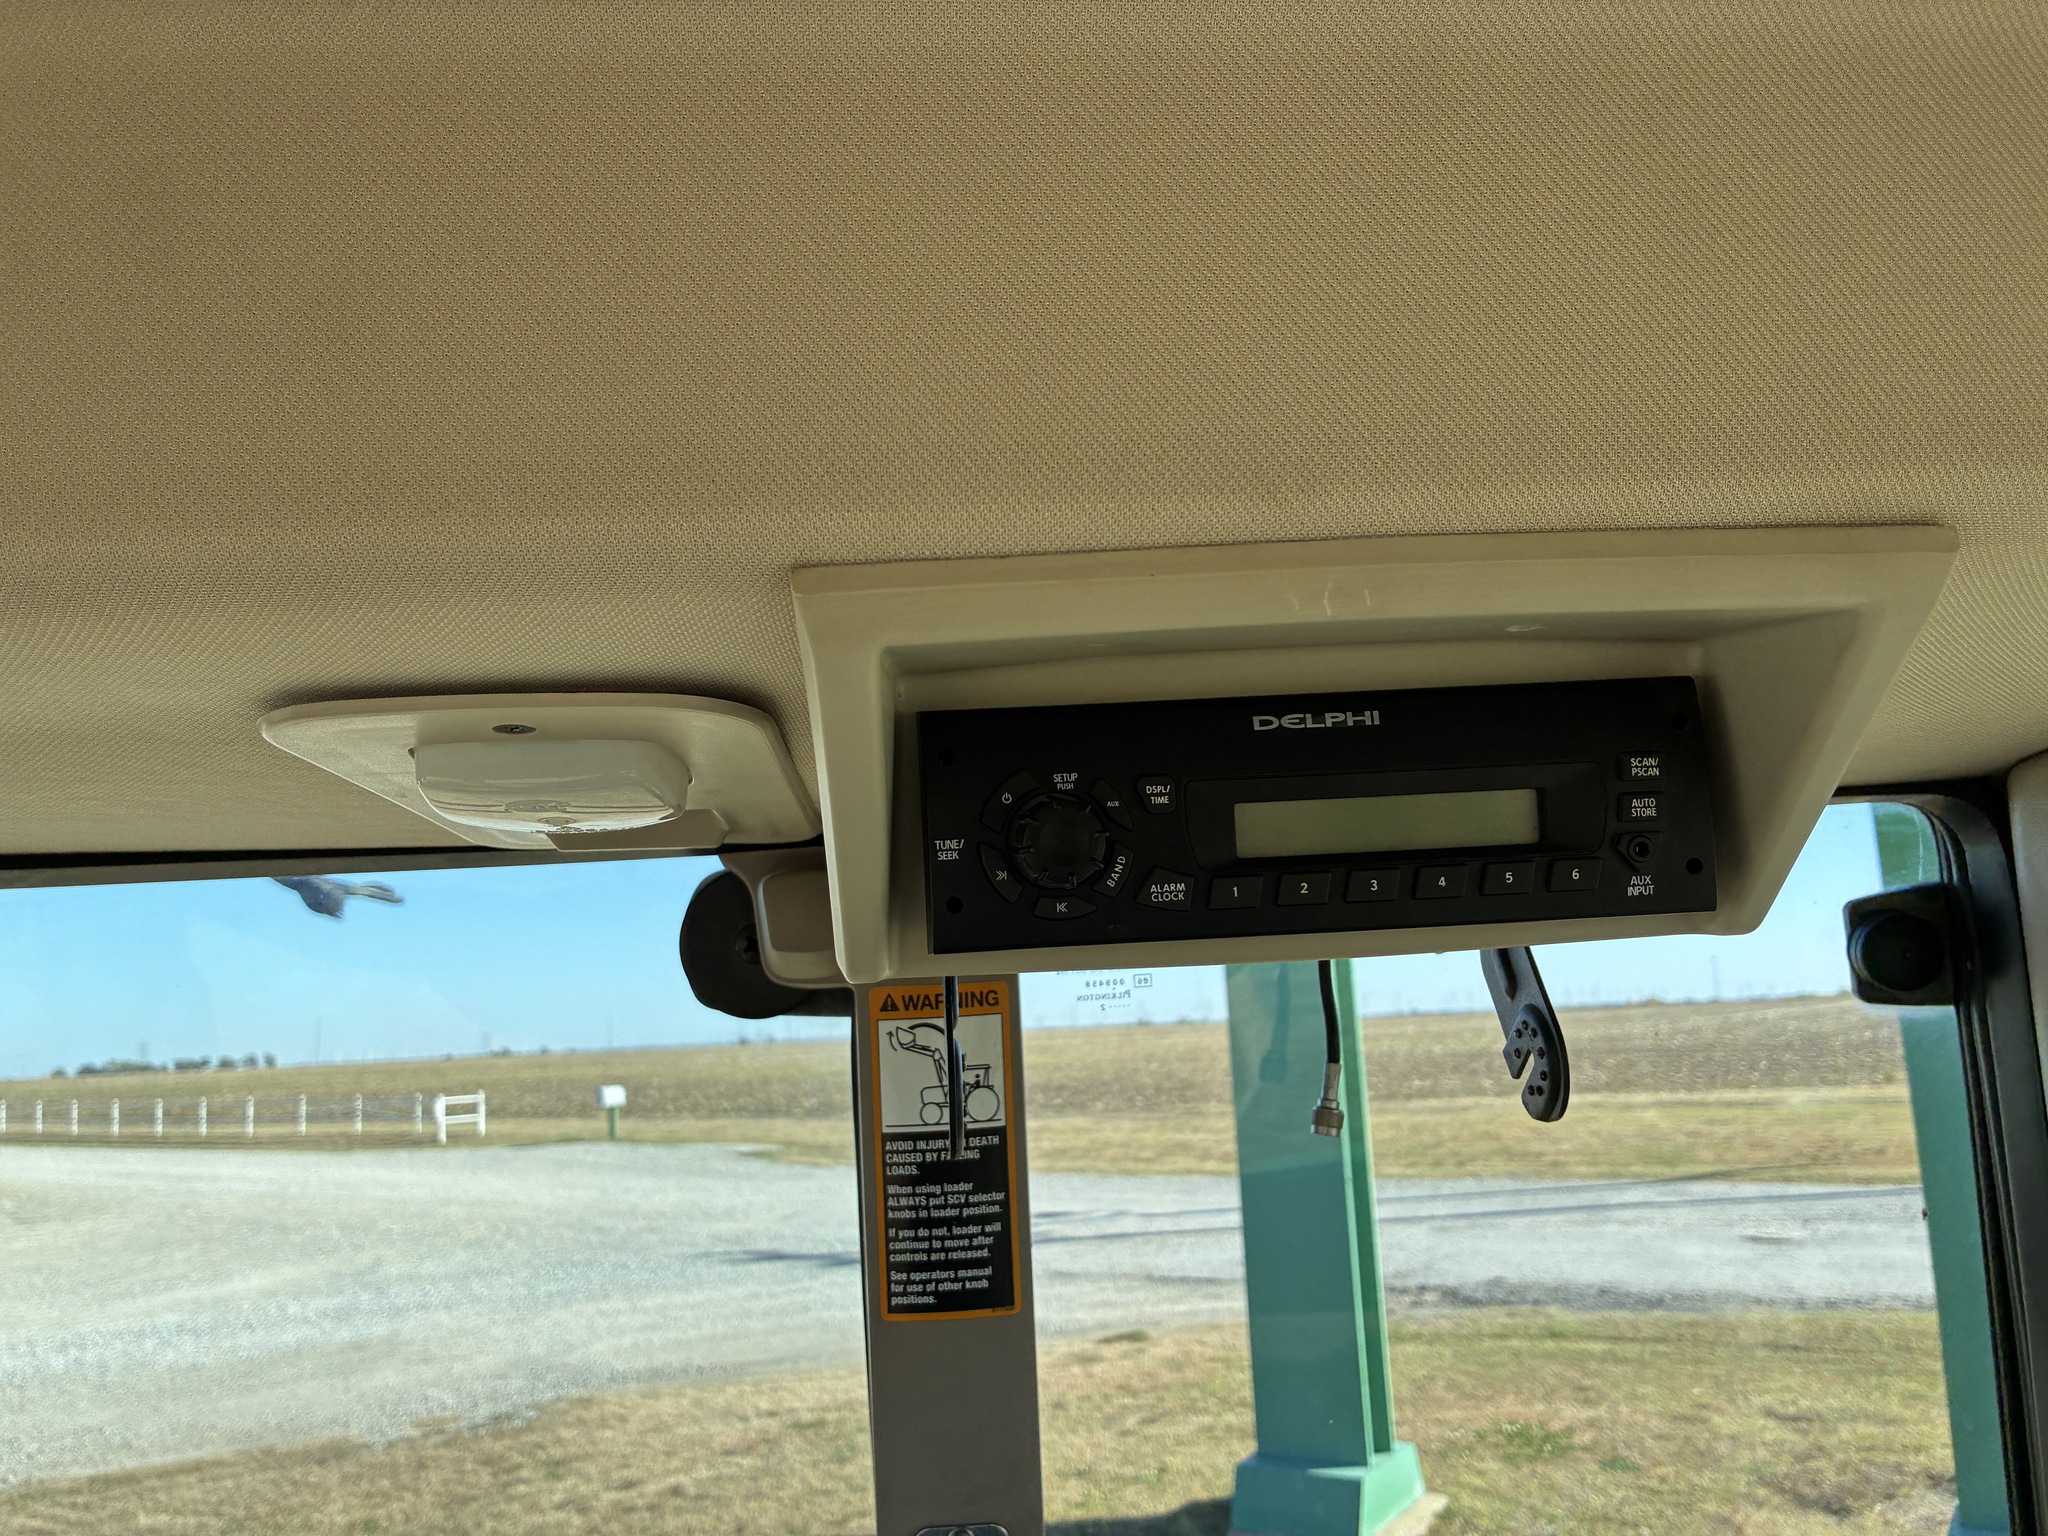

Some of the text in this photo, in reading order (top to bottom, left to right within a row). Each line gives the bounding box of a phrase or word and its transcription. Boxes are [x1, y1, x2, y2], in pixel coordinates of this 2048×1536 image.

[1252, 710, 1381, 731] DELPHI
[1630, 757, 1659, 767] SCAN/
[1631, 767, 1660, 776] PSCAN
[1053, 773, 1078, 783] SETUP
[1146, 785, 1171, 794] DSPL/
[1150, 796, 1170, 805] TIME
[1631, 798, 1656, 808] AUTO
[1631, 808, 1657, 817] STORE
[934, 838, 964, 851] TUNE/
[937, 850, 960, 861] SEEK
[1106, 855, 1126, 887] BAND
[1232, 869, 1581, 898] 1 2 3 4 5 6
[1630, 875, 1652, 886] AUX
[1150, 882, 1186, 893] ALARM
[1627, 885, 1655, 896] INPUT
[1151, 891, 1185, 902] CLOCK
[885, 1140, 914, 1151] AVOID
[916, 1138, 950, 1150] INJURY
[969, 1135, 1000, 1147] DEATH
[886, 1149, 980, 1163] CAUSED BY FAING
[886, 1165, 921, 1175] LOADS.
[887, 1181, 974, 1195] When using loader
[887, 1191, 1005, 1207] ALWAYS put SCV selector
[888, 1204, 1003, 1218] knobs in loader position.
[888, 1227, 896, 1237] If
[898, 1229, 915, 1239] you
[917, 1227, 930, 1237] do
[952, 1223, 982, 1235] loader
[984, 1221, 1002, 1232] will
[889, 1235, 994, 1250] continue to move after
[889, 1247, 991, 1262] controls are released.
[890, 1265, 993, 1281] See operators manual
[891, 1278, 989, 1292] for use of other knob
[891, 1294, 937, 1306] positions.
